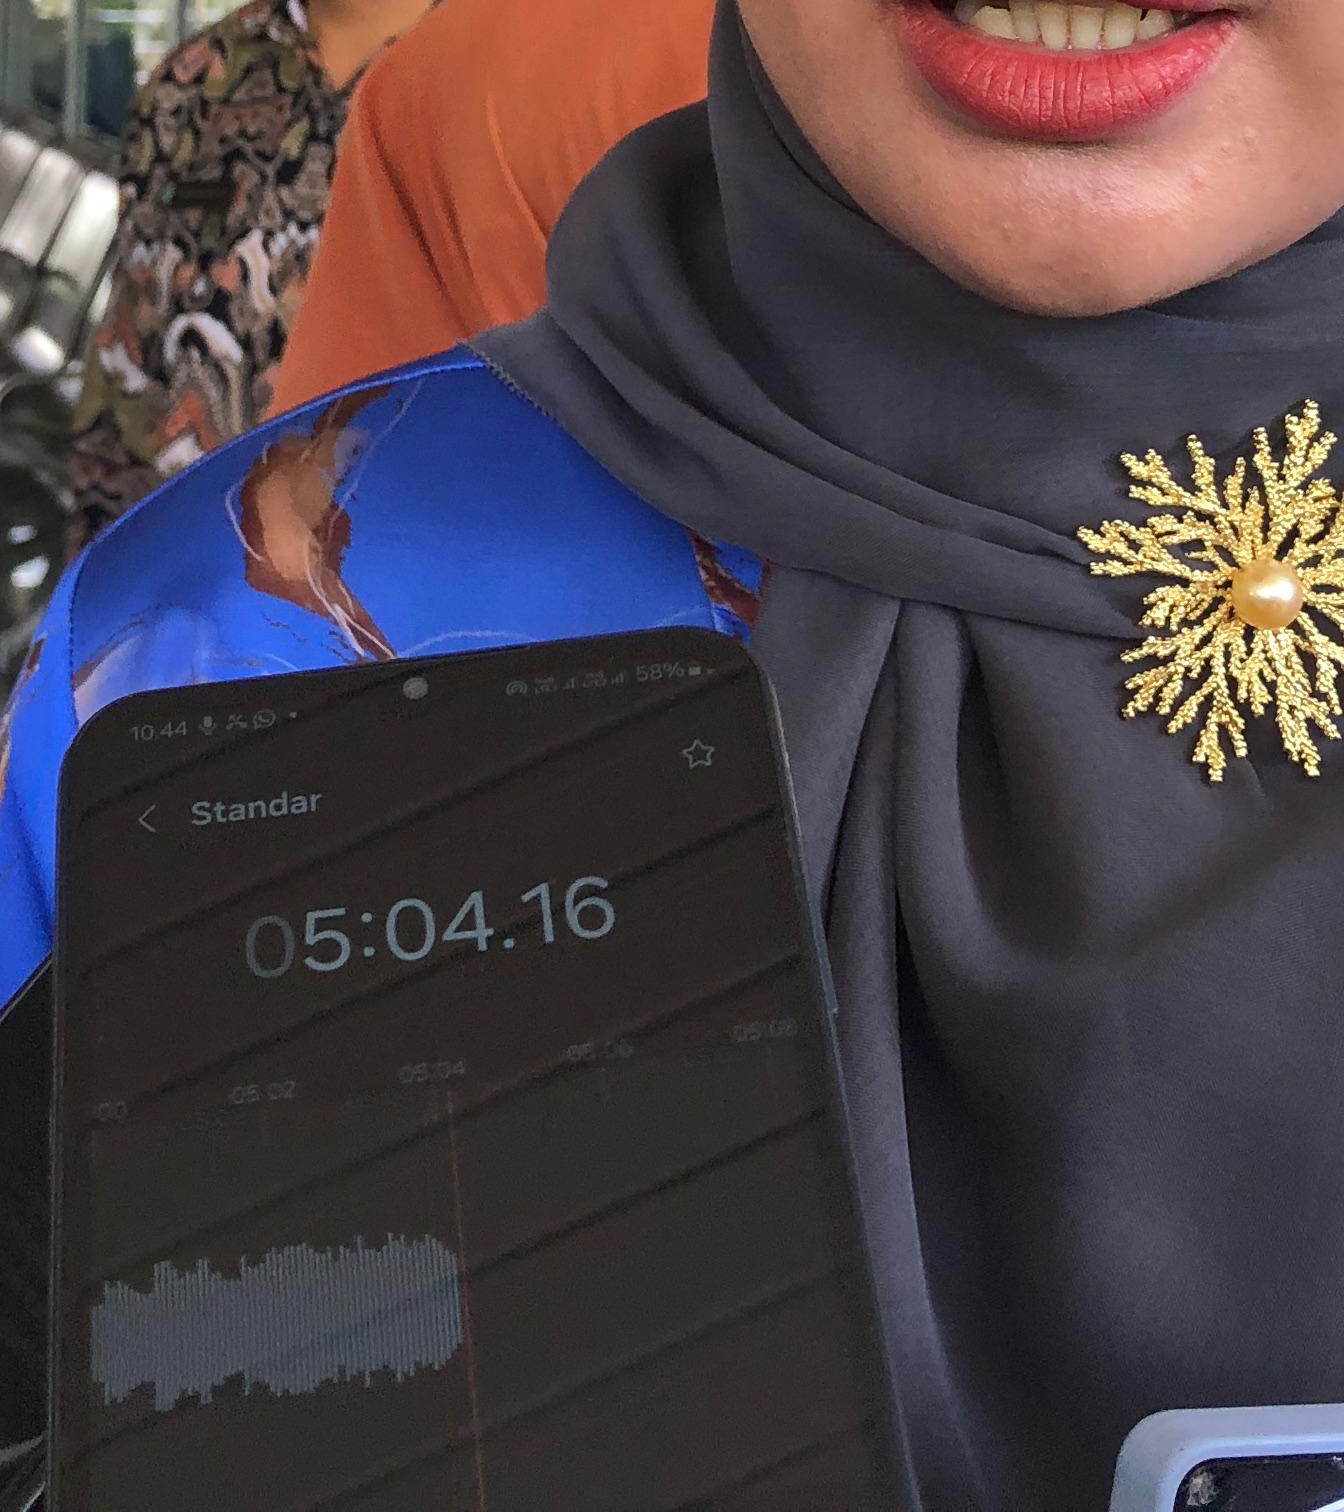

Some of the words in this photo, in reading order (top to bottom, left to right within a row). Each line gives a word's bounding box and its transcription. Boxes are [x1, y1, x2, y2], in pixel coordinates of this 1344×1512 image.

[635, 661, 686, 683] 58%
[190, 790, 324, 828] Standar
[245, 874, 617, 980] 05:04.16
